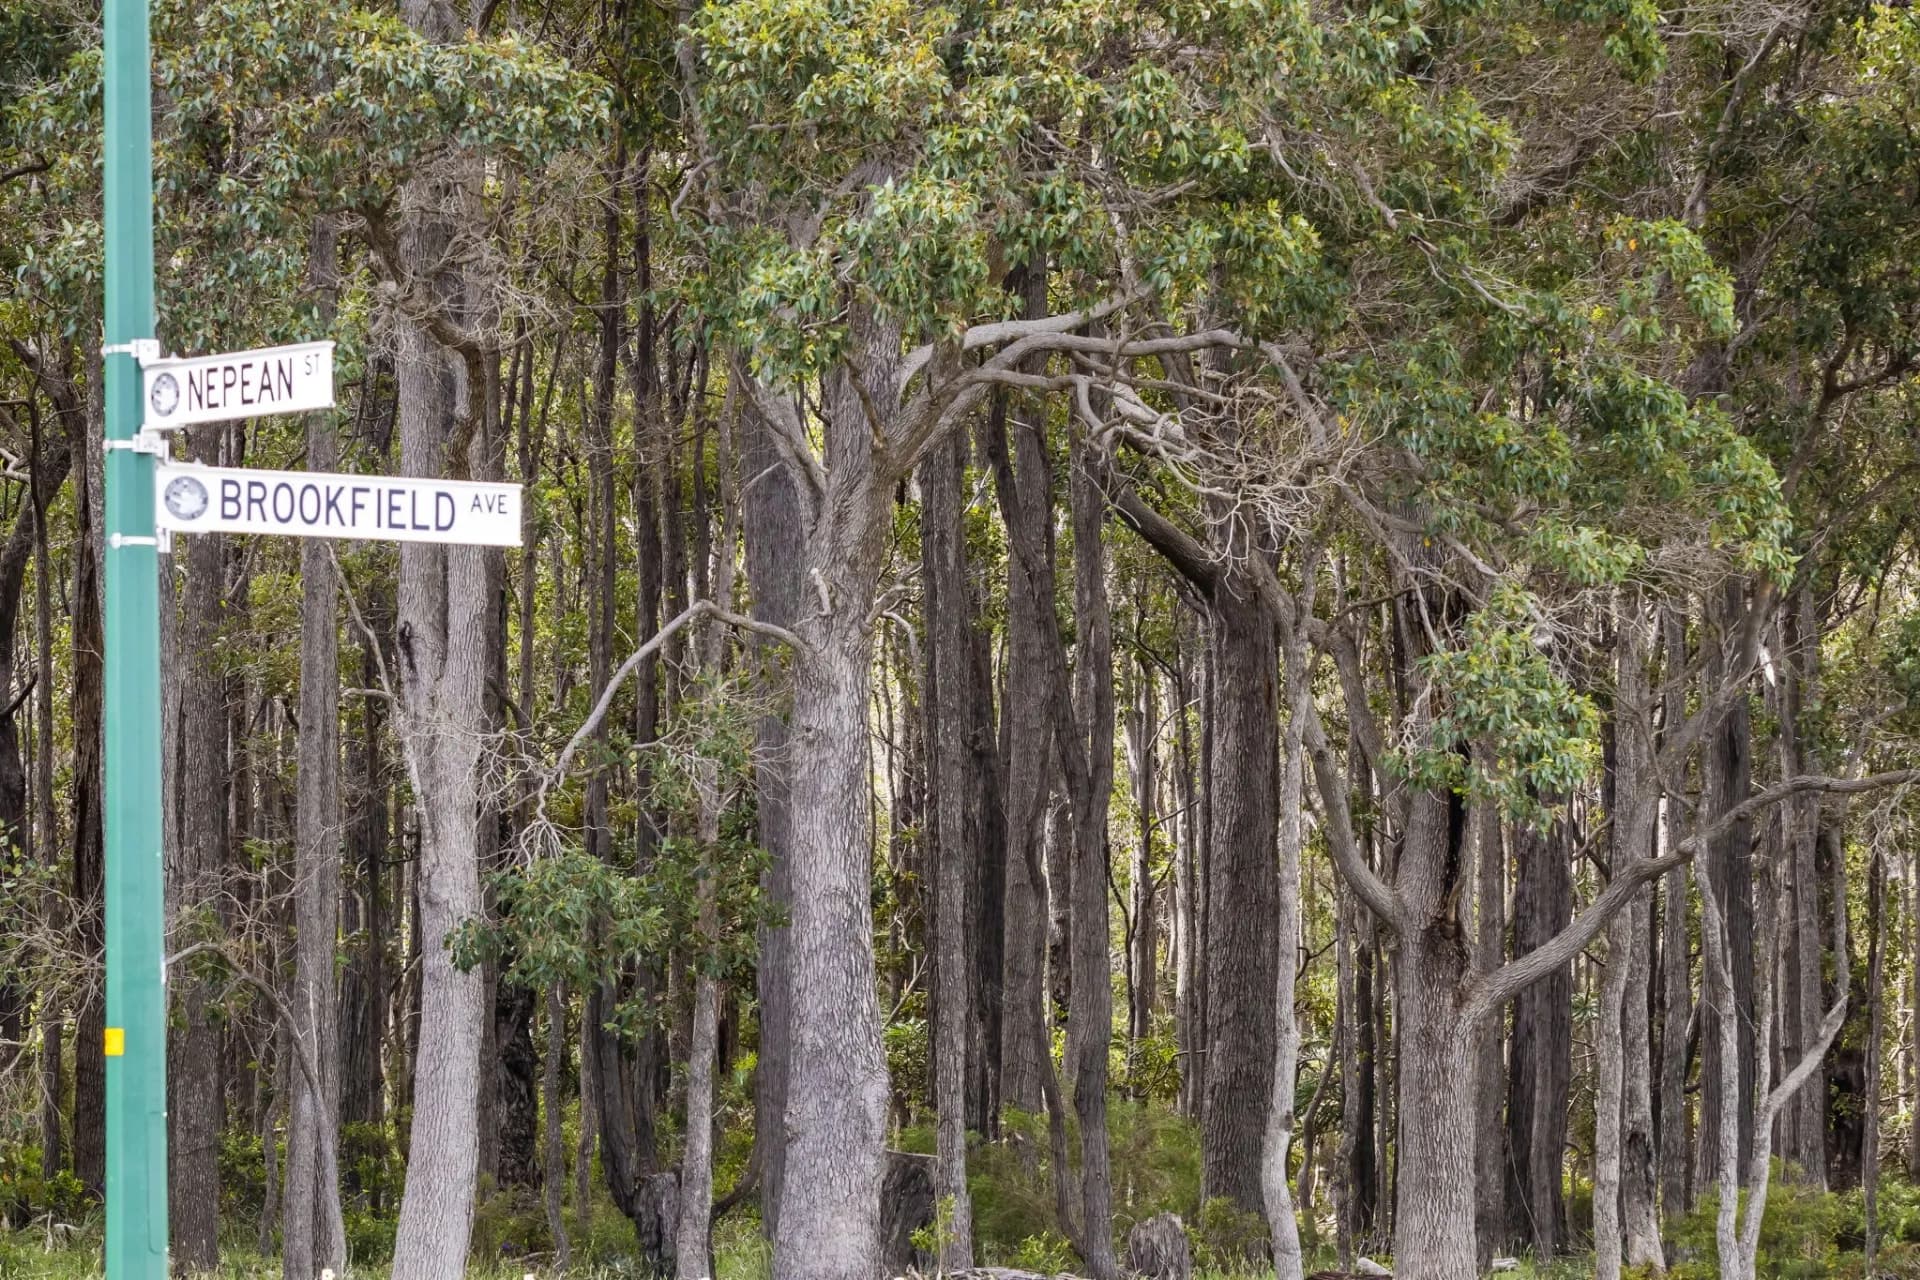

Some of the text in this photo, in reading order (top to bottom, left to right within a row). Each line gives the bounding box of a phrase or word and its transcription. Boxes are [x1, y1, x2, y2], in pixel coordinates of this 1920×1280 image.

[188, 353, 320, 411] NEPEAN ST
[220, 479, 508, 532] BROOKFIELD AVE
